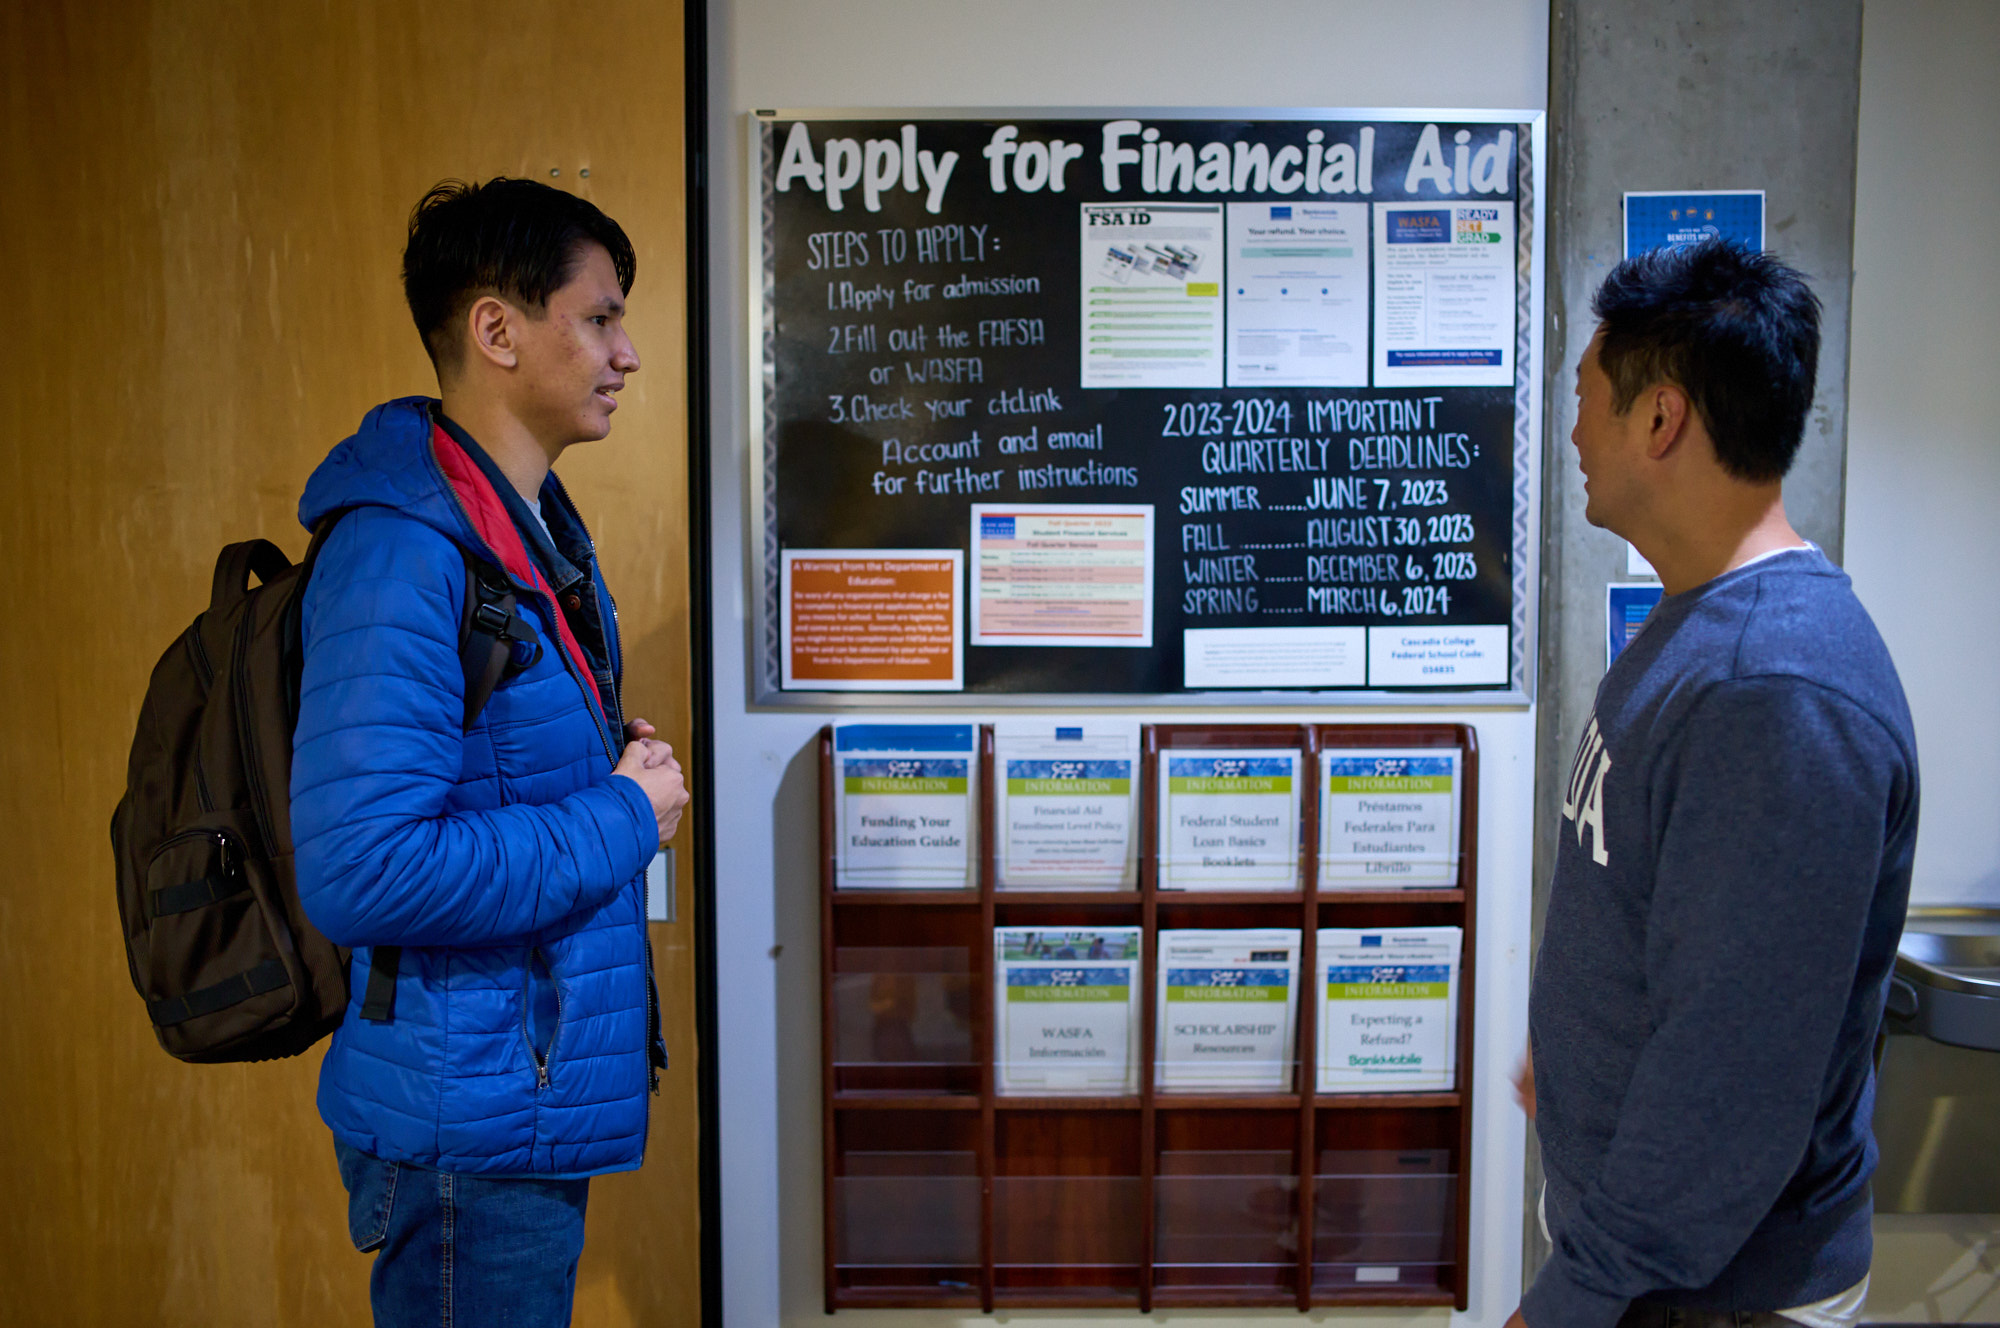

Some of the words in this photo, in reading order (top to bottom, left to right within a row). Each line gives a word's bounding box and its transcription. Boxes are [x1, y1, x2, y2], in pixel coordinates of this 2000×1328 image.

[776, 122, 959, 213] Apply
[983, 125, 1083, 192] for
[1101, 120, 1375, 194] Financial
[1404, 123, 1513, 195] Aid
[1089, 212, 1125, 226] FSA
[1129, 212, 1152, 226] ID
[1456, 209, 1498, 220] READY
[1398, 216, 1440, 228] WASFA
[1457, 232, 1491, 243] GRAD
[807, 231, 869, 270] STEPS
[877, 228, 907, 266] TO
[916, 225, 1000, 263] APPLY:
[903, 279, 935, 303] for
[942, 274, 1041, 299] admission
[888, 324, 928, 352] out
[936, 324, 970, 349] the
[978, 318, 1045, 347] FAFSA
[869, 365, 895, 385] or
[905, 357, 983, 384] WASFA
[925, 397, 972, 422] your
[988, 387, 1063, 415] ctcLink
[1162, 399, 1294, 437] 2023-2024
[1307, 396, 1443, 433] IMPORTANT
[882, 430, 982, 466] Account
[998, 426, 1038, 455] and
[1047, 424, 1103, 452] email
[1202, 438, 1331, 475] QUARTERLY
[1349, 433, 1480, 471] DEADLINES:
[872, 472, 907, 495] for
[915, 467, 1004, 495] further
[1018, 459, 1139, 491] instructions
[1179, 485, 1262, 515] SUMMER
[1306, 475, 1368, 510] JUNE
[1401, 479, 1449, 506] 2023
[1181, 523, 1230, 552] FALL
[1307, 516, 1392, 548] AUGUST
[793, 562, 800, 571] A
[802, 562, 841, 573] Warning
[842, 562, 865, 571] from
[866, 562, 882, 571] the
[884, 562, 939, 573] Department
[941, 562, 952, 571] of
[1183, 555, 1259, 585] WINTER
[1307, 553, 1400, 583] DECEMBER
[1432, 551, 1477, 580] 2023
[1182, 588, 1259, 615] SPRING
[1307, 586, 1377, 614] MARCH
[1401, 638, 1440, 646] Cascadia
[1443, 637, 1475, 646] College
[1392, 651, 1426, 659] Federal
[862, 779, 948, 791] INFORMATION
[1025, 781, 1111, 792] INFORMATION
[1187, 779, 1273, 790] INFORMATION
[1348, 779, 1433, 790] INFORMATION
[1034, 805, 1080, 816] Financial
[1083, 805, 1102, 816] Aid
[861, 816, 916, 830] Funding
[919, 816, 951, 828] Your
[1013, 822, 1064, 831] Enrollment
[1067, 822, 1092, 831] Level
[1095, 822, 1122, 832] Policy
[1180, 815, 1227, 827] Federal
[1230, 815, 1279, 827] Student
[1344, 821, 1402, 833] Federales
[1407, 821, 1435, 833] Para
[852, 835, 916, 848] Education
[920, 835, 960, 848] Guide
[1193, 836, 1224, 848] Loan
[1228, 836, 1266, 848] Basics
[1353, 842, 1425, 853] Estudiantes
[1202, 856, 1255, 868] Booklets
[1365, 861, 1411, 873] Librillo
[1024, 987, 1110, 998] INFORMATION
[1184, 988, 1269, 999] INFORMATION
[1345, 984, 1429, 996] INFORMATION
[1350, 1014, 1412, 1027] Expecting
[1415, 1016, 1422, 1024] a
[1042, 1028, 1093, 1039] WASFA
[1174, 1024, 1276, 1036] SCHOLARSHIP
[1360, 1033, 1412, 1045] Refund?
[1193, 1043, 1255, 1054] Resources
[1349, 1053, 1422, 1066] BankMobile
